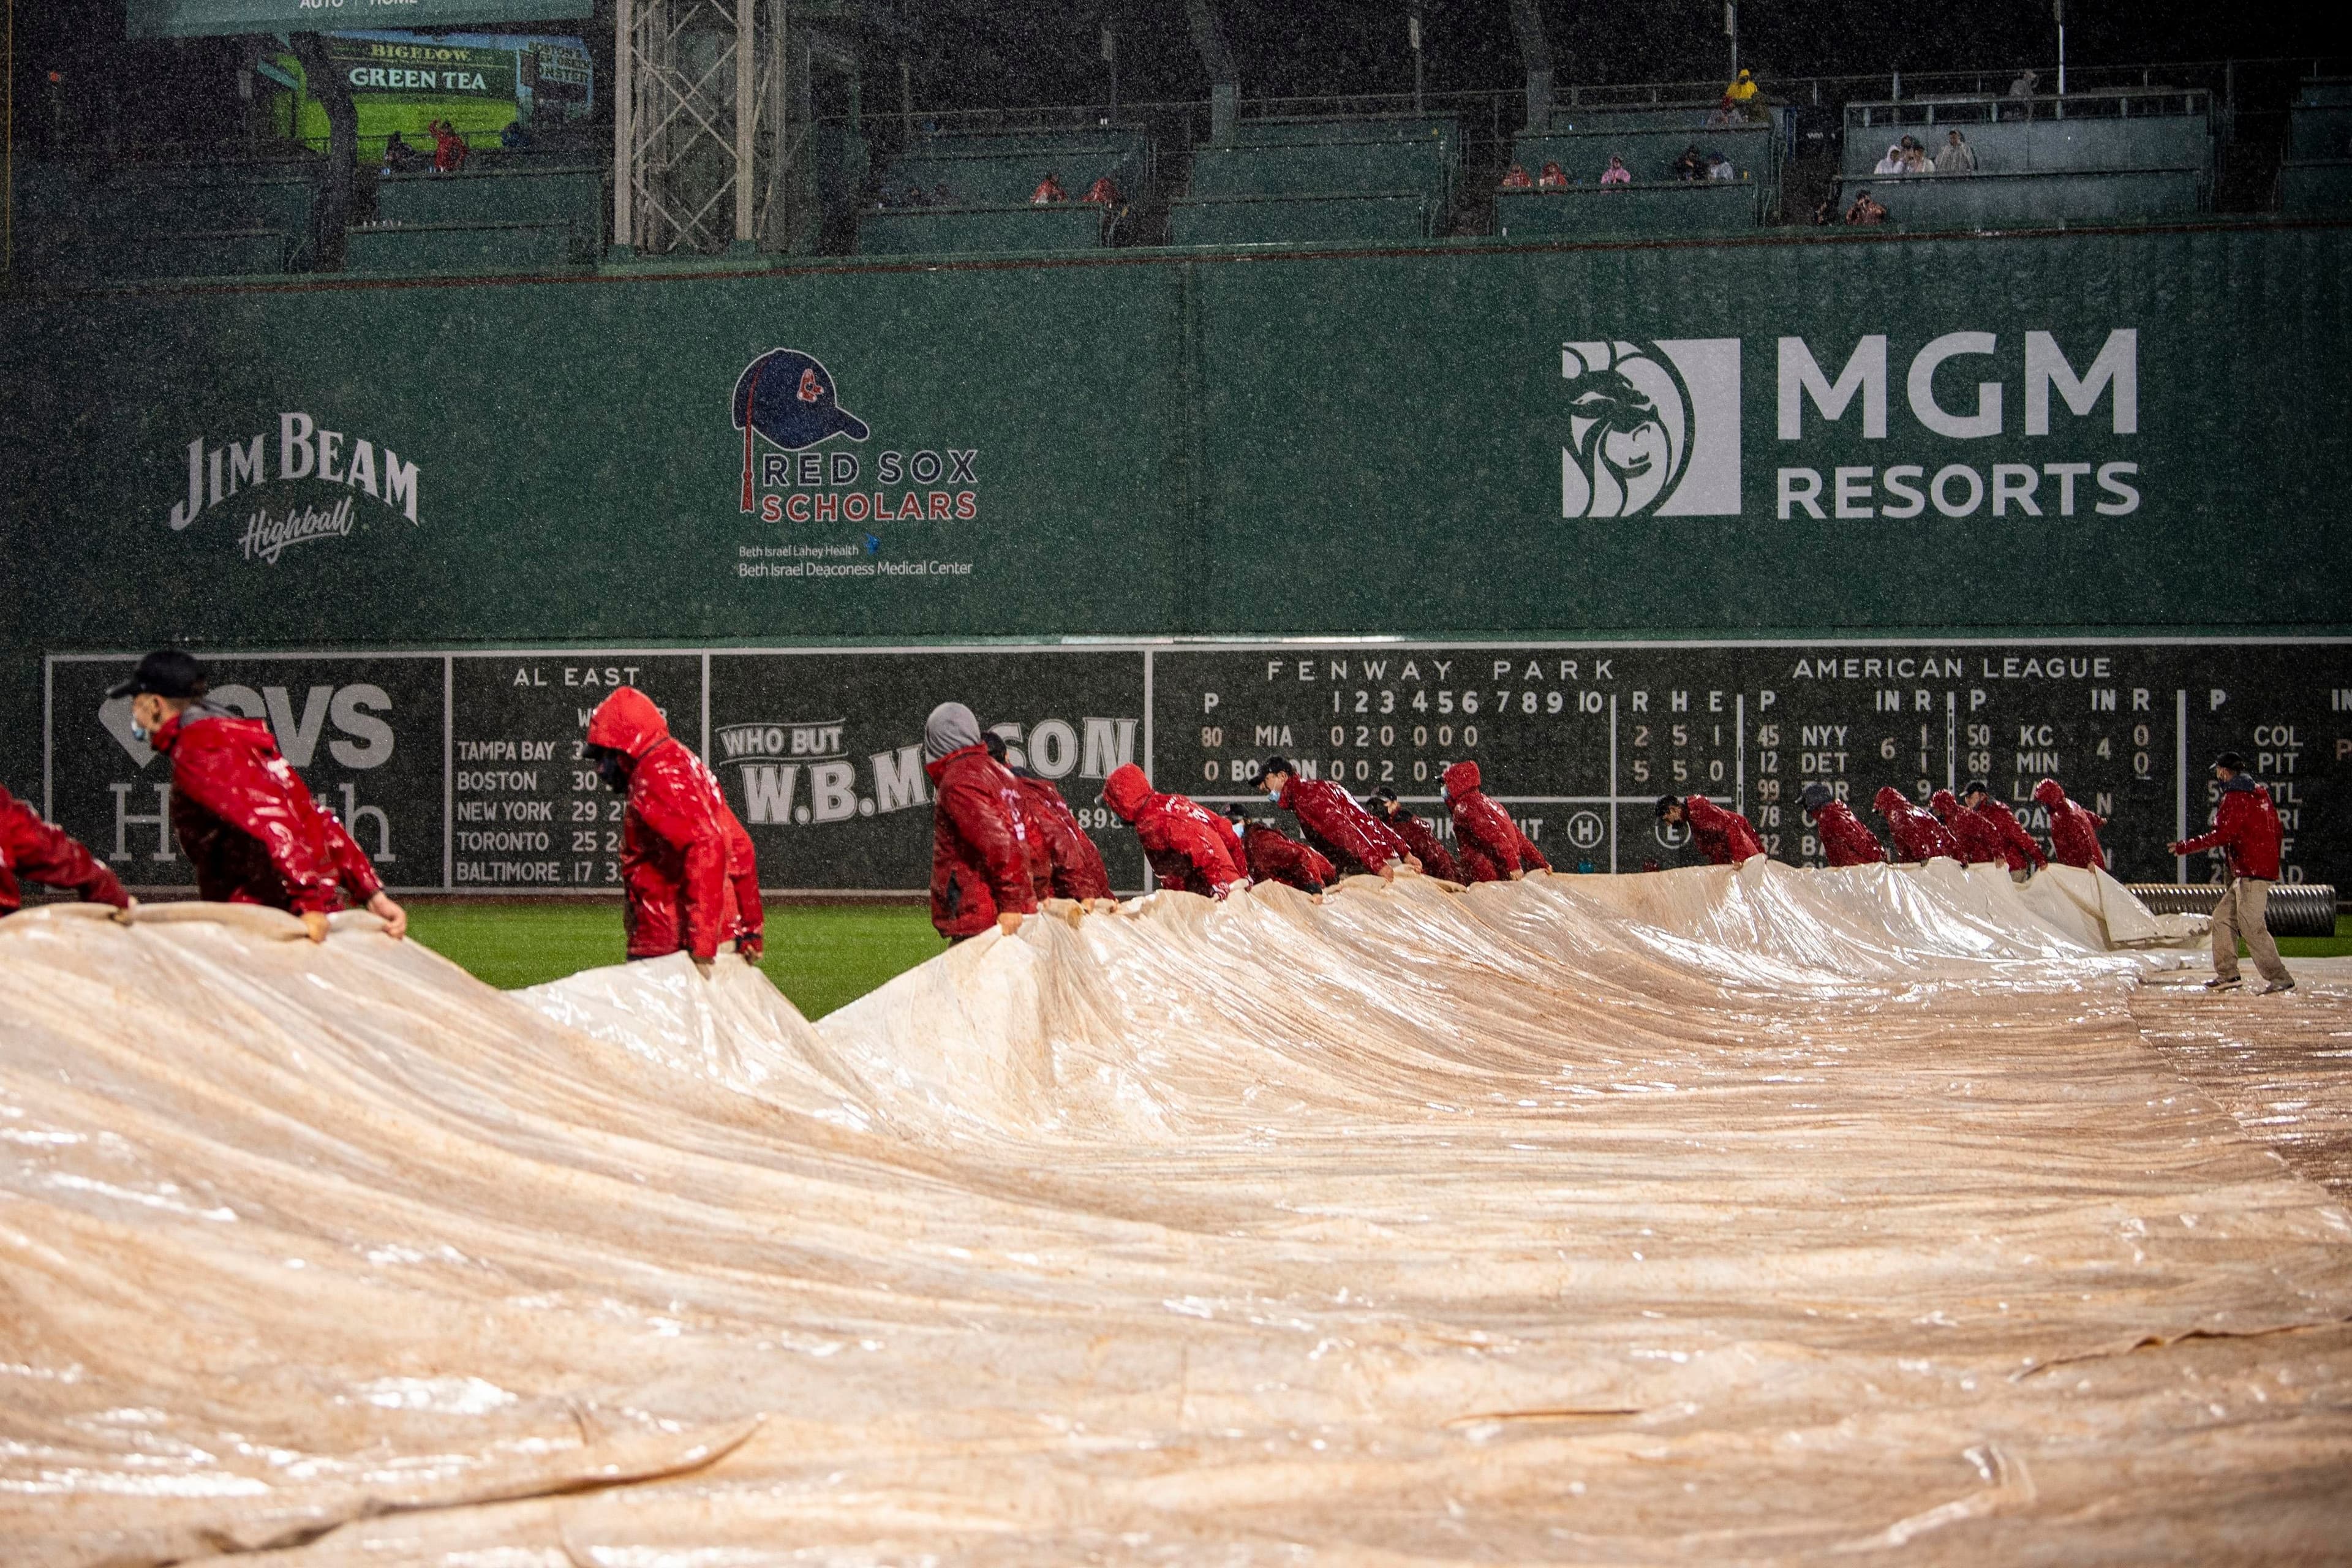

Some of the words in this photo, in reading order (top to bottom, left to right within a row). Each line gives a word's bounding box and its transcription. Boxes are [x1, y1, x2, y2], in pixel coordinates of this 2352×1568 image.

[372, 43, 470, 61] BIGELOW
[349, 67, 436, 88] GREEN
[443, 72, 487, 90] TEA
[539, 67, 589, 84] ONSTER
[1778, 329, 2137, 440] MGM
[170, 432, 269, 530] JIM
[278, 412, 421, 527] BEAM
[763, 452, 859, 486] RED
[878, 450, 979, 484] SOX
[1778, 462, 2140, 519] RESORTS
[761, 491, 978, 522] SCHOLARS
[238, 496, 355, 565] Highball
[739, 546, 762, 557] Beth
[765, 545, 791, 556] Israel
[794, 545, 823, 558] Lahey
[826, 544, 858, 556] Health
[739, 563, 768, 576] Beth
[771, 562, 803, 576] Israel
[807, 562, 874, 576] Deaconess
[877, 560, 926, 575] Medical
[929, 560, 973, 575] Center
[513, 668, 547, 686] AL
[564, 667, 640, 686] EAST
[1268, 660, 1452, 681] FENWAY
[1494, 660, 1613, 680] PARK
[1793, 658, 1961, 679] AMERICAN
[1983, 657, 2111, 679] LEAGUE
[1204, 693, 1219, 714] P
[1333, 692, 1340, 713] 1
[1355, 692, 1369, 713] 2
[1381, 691, 1395, 713] 3
[1412, 690, 1428, 713] 4
[1438, 691, 1453, 713] 5
[1462, 691, 1479, 714] 6
[1498, 691, 1510, 713] 7
[1522, 692, 1538, 714] 8
[1547, 691, 1563, 713] 9
[1579, 691, 1603, 713] 10
[1632, 691, 1648, 712] R
[1672, 691, 1687, 712] H
[1709, 690, 1722, 712] E
[1760, 690, 1775, 711] P
[1876, 690, 1899, 711] IN
[1915, 689, 1931, 711] R
[1970, 689, 1986, 711] P
[2092, 689, 2116, 710] IN
[2133, 688, 2150, 711] R
[2211, 689, 2226, 711] P
[720, 728, 783, 758] WHO
[791, 725, 842, 755] BUT
[1202, 726, 1223, 747] 80
[1255, 725, 1292, 747] MIA
[1331, 725, 1344, 747] 0
[1356, 725, 1370, 747] 2
[1381, 725, 1394, 747] 0
[1414, 725, 1427, 747] 0
[1439, 725, 1452, 747] 0
[1464, 725, 1477, 747] 0
[1634, 725, 1649, 747] 2
[1672, 725, 1687, 746] 5
[1715, 725, 1719, 746] 1
[1758, 725, 1779, 747] 45
[1802, 725, 1848, 746] NYY
[1881, 737, 1896, 760] 6
[1967, 725, 1990, 747] 50
[2021, 725, 2053, 746] KC
[2097, 737, 2111, 760] 4
[2134, 725, 2149, 747] 0
[2254, 725, 2304, 747] COL
[458, 741, 516, 761] TAMPA
[521, 741, 555, 761] BAY
[741, 717, 1138, 824] W.B.MSON
[1205, 761, 1219, 782] 0
[1232, 760, 1317, 782] BON
[1331, 760, 1344, 781] 0
[1356, 760, 1370, 781] 0
[1381, 760, 1395, 781] 2
[1414, 760, 1427, 782] 0
[1634, 760, 1649, 781] 5
[1673, 760, 1688, 781] 5
[1710, 760, 1724, 781] 0
[1760, 752, 1777, 773] 12
[1801, 752, 1849, 774] DET
[1967, 752, 1991, 773] 68
[2016, 752, 2059, 774] MIN
[2133, 752, 2149, 774] 0
[2258, 753, 2299, 774] PIT
[458, 771, 537, 791] BOSTON
[571, 771, 598, 791] 30
[1758, 779, 1779, 801] 99
[1917, 779, 1931, 800] 9
[458, 801, 499, 821] NEW
[504, 801, 552, 821] YORK
[571, 801, 597, 821] 29
[2097, 792, 2111, 815] N
[1070, 809, 1123, 829] 898
[1758, 805, 1779, 827] 78
[458, 832, 549, 852] TORONTO
[571, 832, 597, 852] 25
[1578, 820, 1593, 842] H
[456, 862, 560, 882] BALTIMORE
[574, 862, 593, 882] 17
